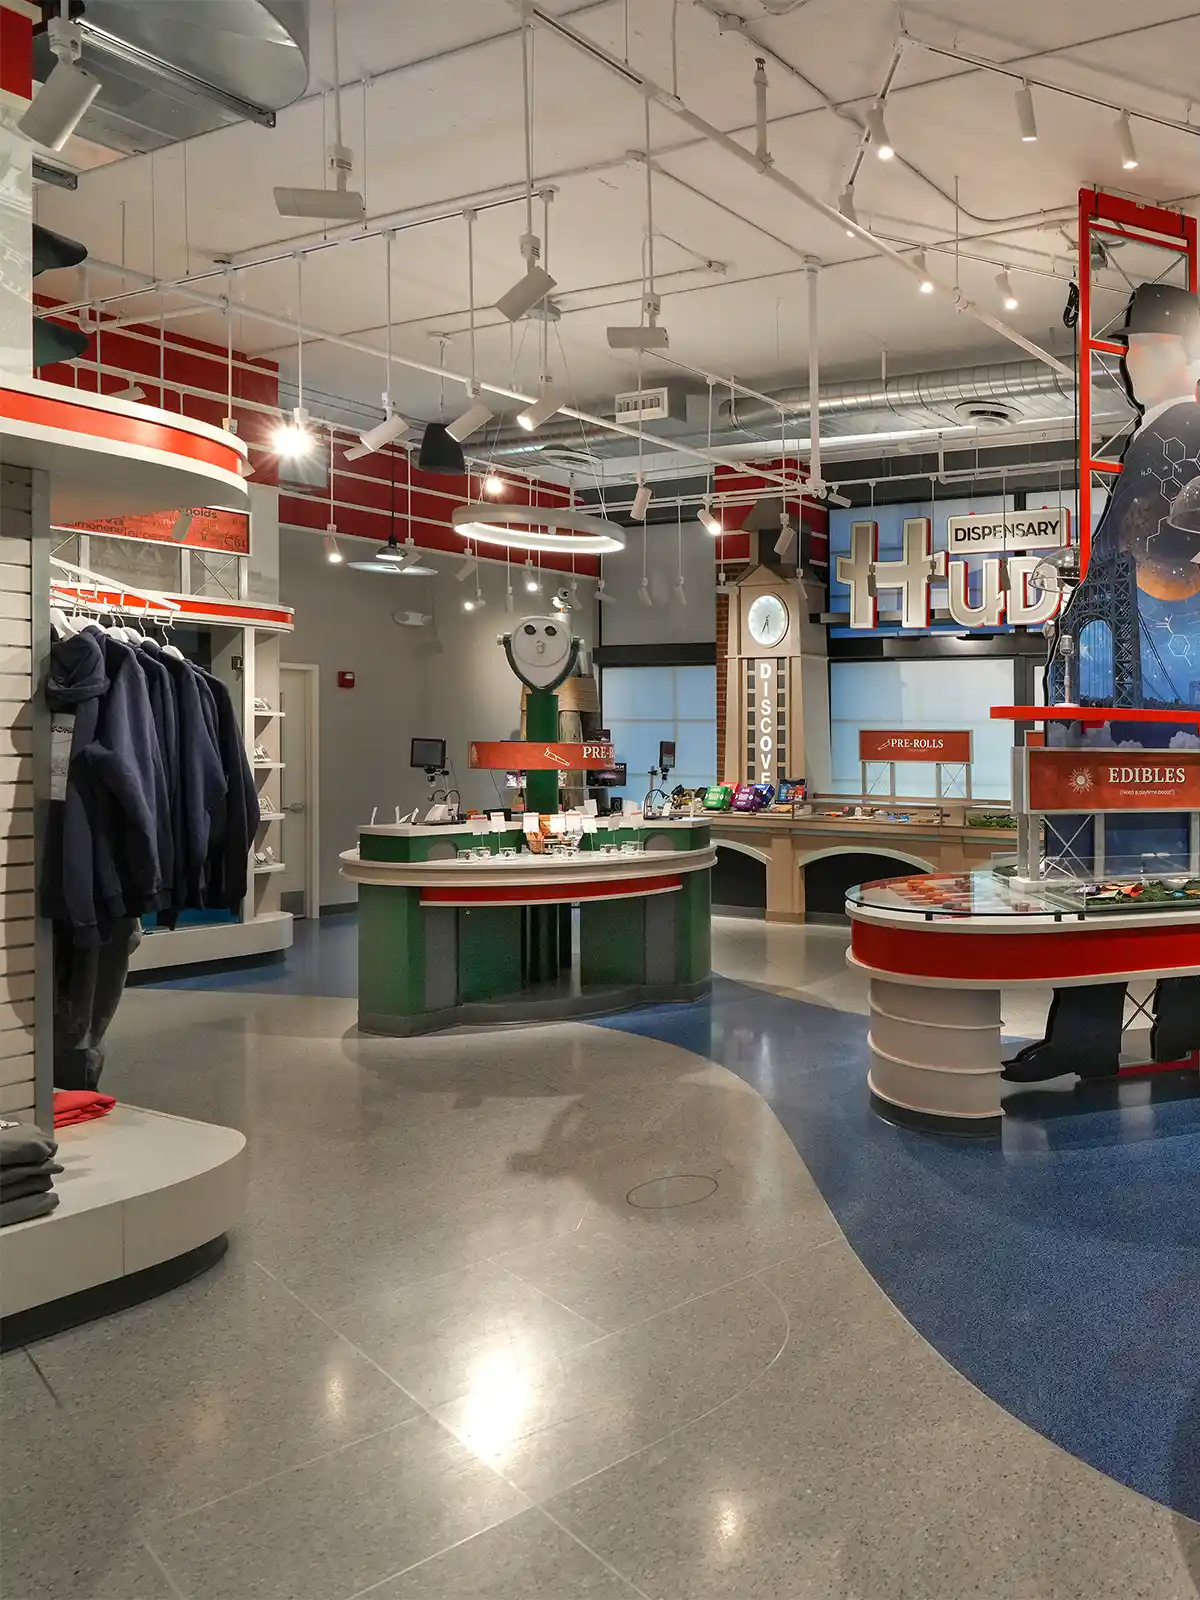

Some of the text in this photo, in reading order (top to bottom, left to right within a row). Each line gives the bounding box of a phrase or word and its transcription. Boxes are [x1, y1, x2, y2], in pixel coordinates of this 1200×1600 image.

[955, 521, 1060, 541] DISPENSARY
[891, 738, 944, 749] PRE-ROLLS
[1108, 767, 1186, 783] EDIBLES
